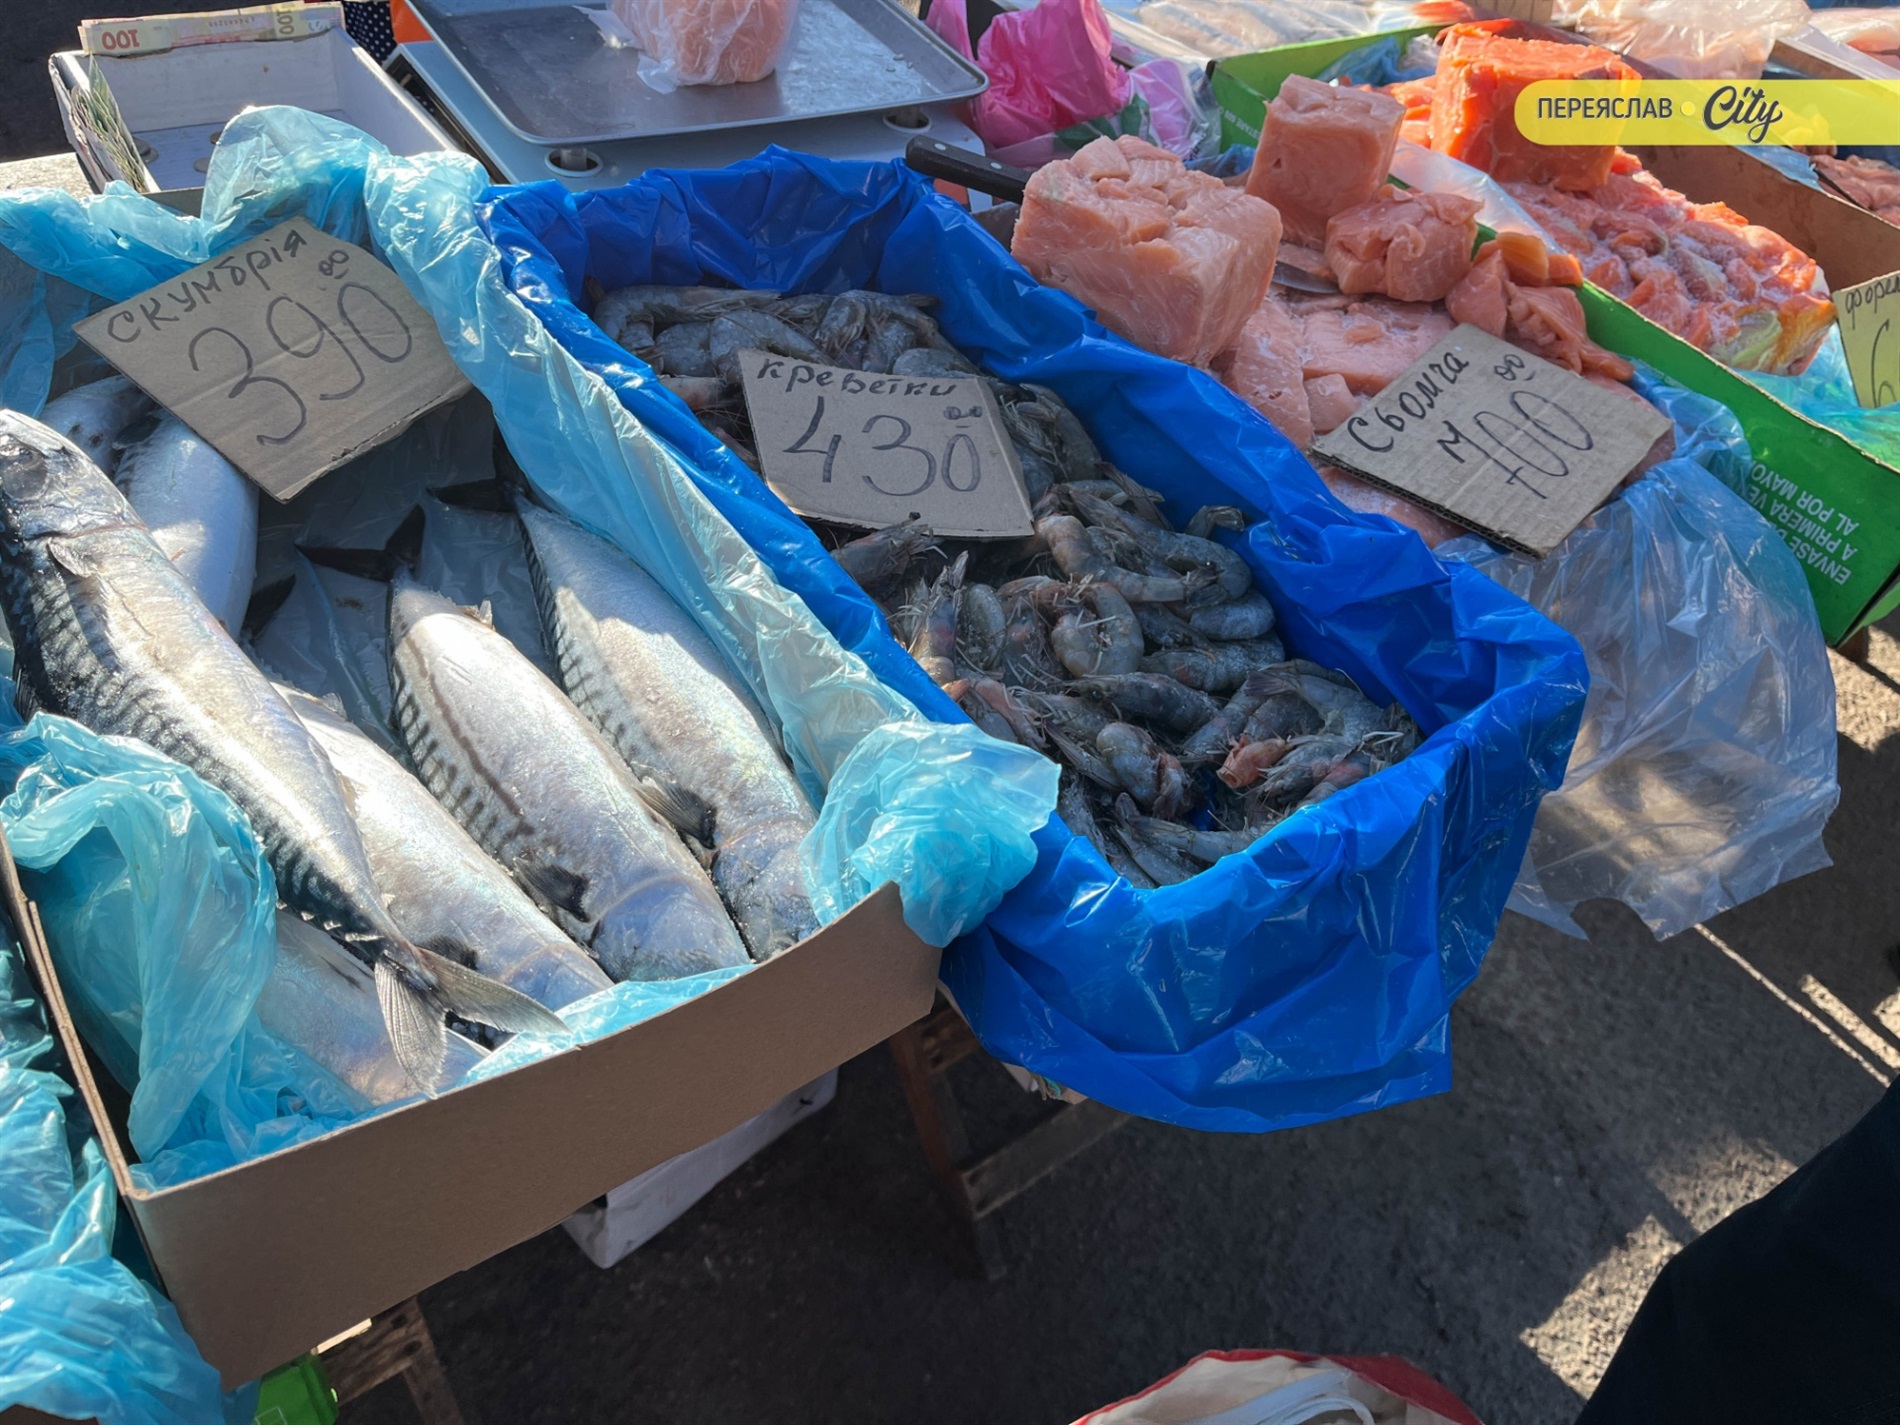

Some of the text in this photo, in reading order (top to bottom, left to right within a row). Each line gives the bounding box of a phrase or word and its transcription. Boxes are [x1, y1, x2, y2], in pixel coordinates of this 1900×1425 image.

[101, 29, 141, 50] 100
[276, 9, 295, 35] 100
[188, 282, 412, 446] 390
[757, 358, 957, 397] креветки
[782, 395, 981, 497] 430
[1750, 461, 1860, 536] AL POR MAYO
[1769, 499, 1842, 554] PRIMERA
[1789, 536, 1852, 585] ENVASE
[1842, 543, 1858, 562] A
